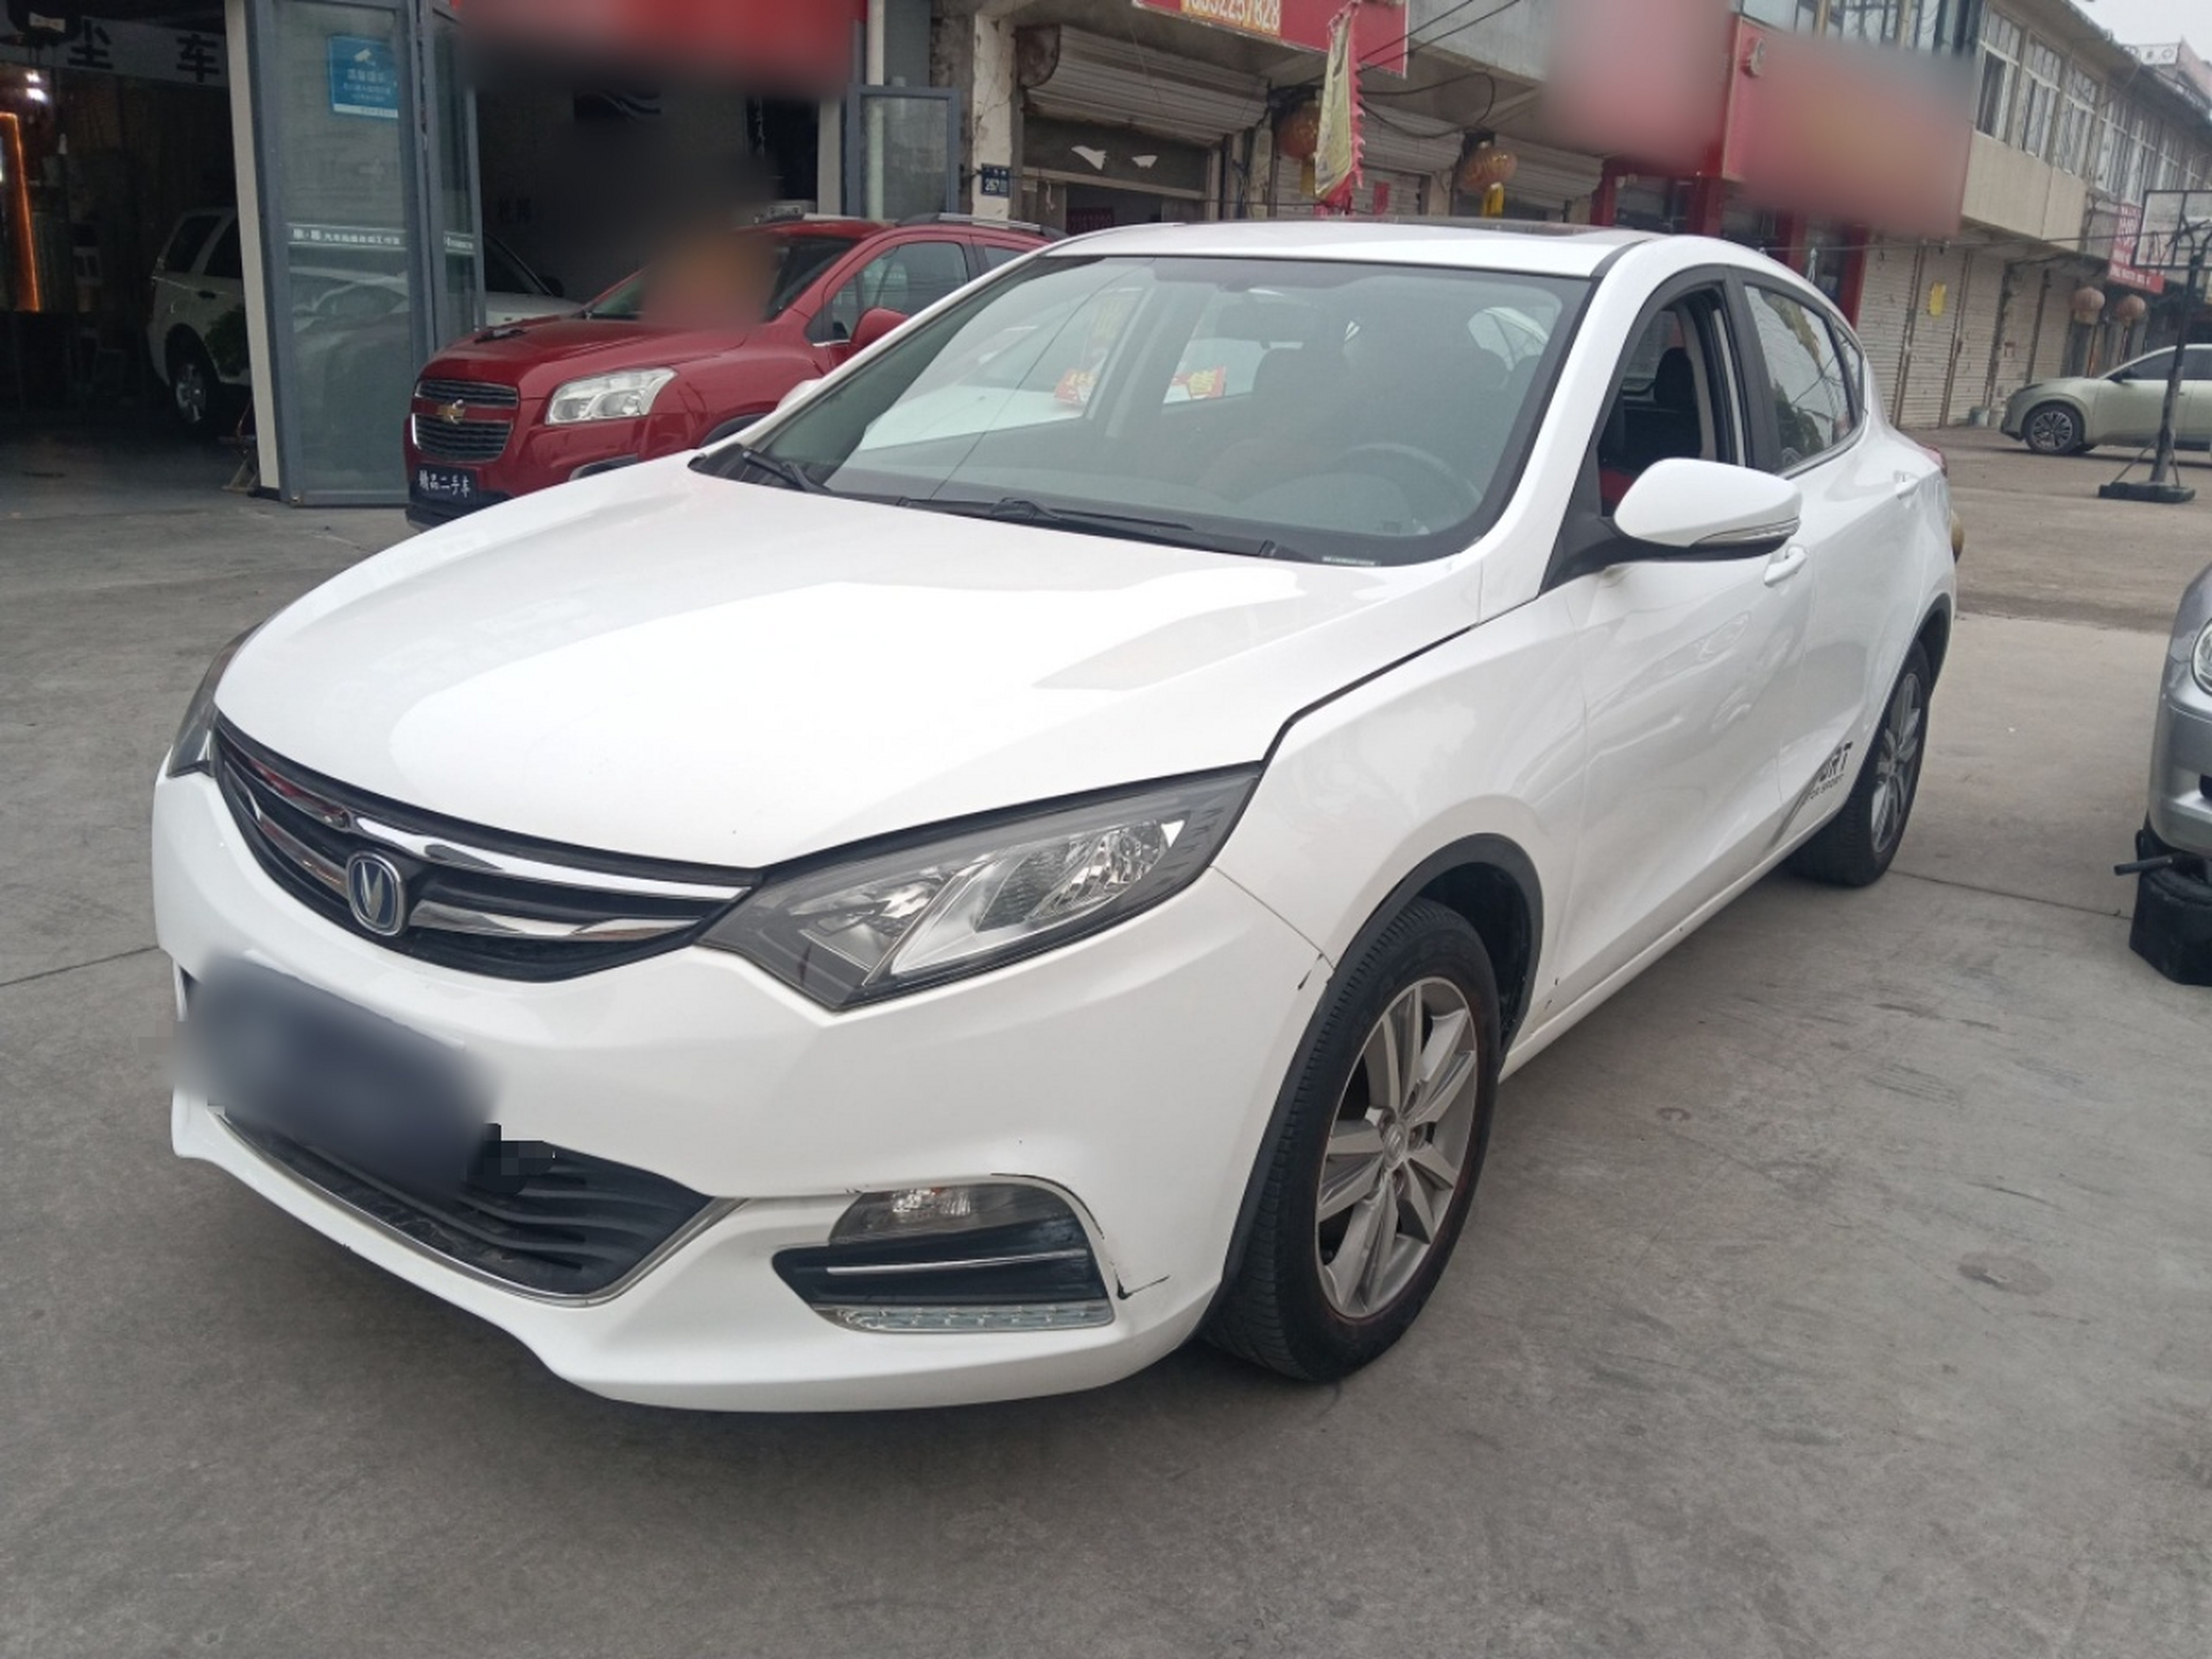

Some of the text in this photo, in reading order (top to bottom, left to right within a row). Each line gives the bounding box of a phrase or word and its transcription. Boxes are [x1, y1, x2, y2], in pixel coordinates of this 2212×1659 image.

[419, 469, 471, 498] 精品二手车
